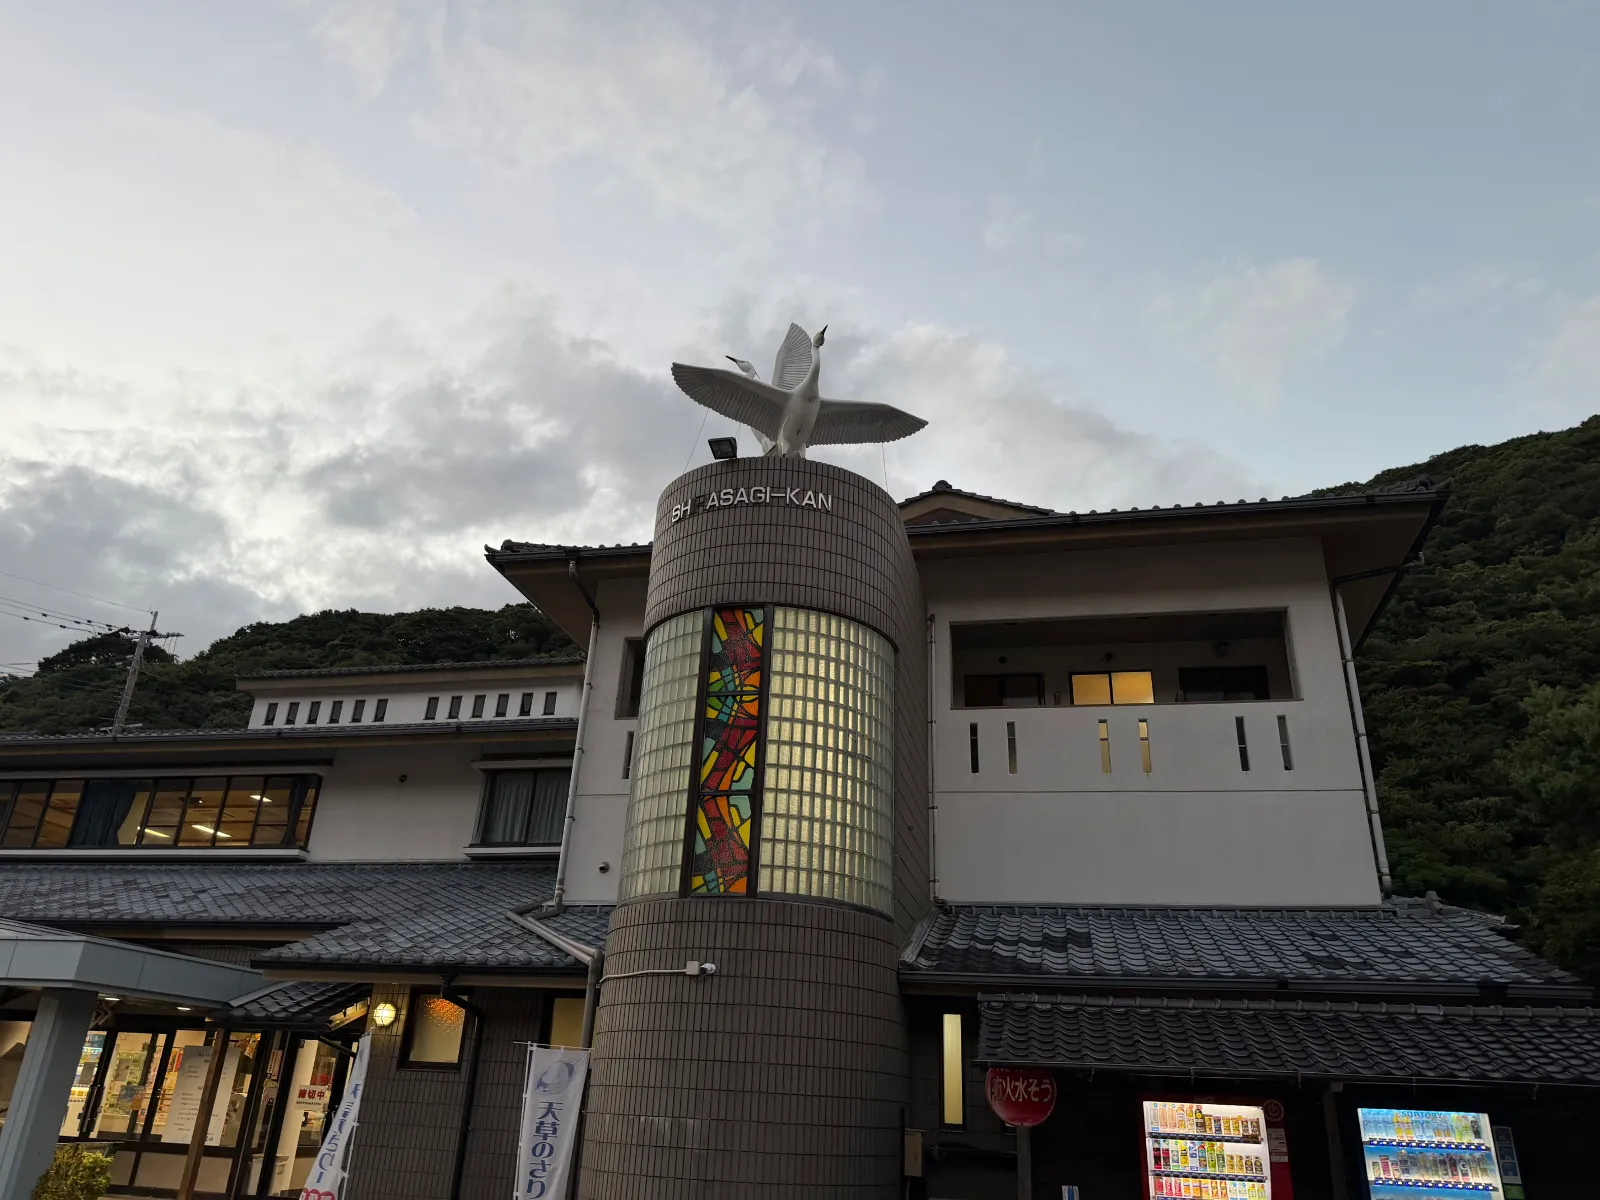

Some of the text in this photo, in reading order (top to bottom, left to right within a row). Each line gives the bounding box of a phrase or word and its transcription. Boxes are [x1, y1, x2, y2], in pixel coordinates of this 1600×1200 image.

[526, 1101, 564, 1199] 天草のさり
